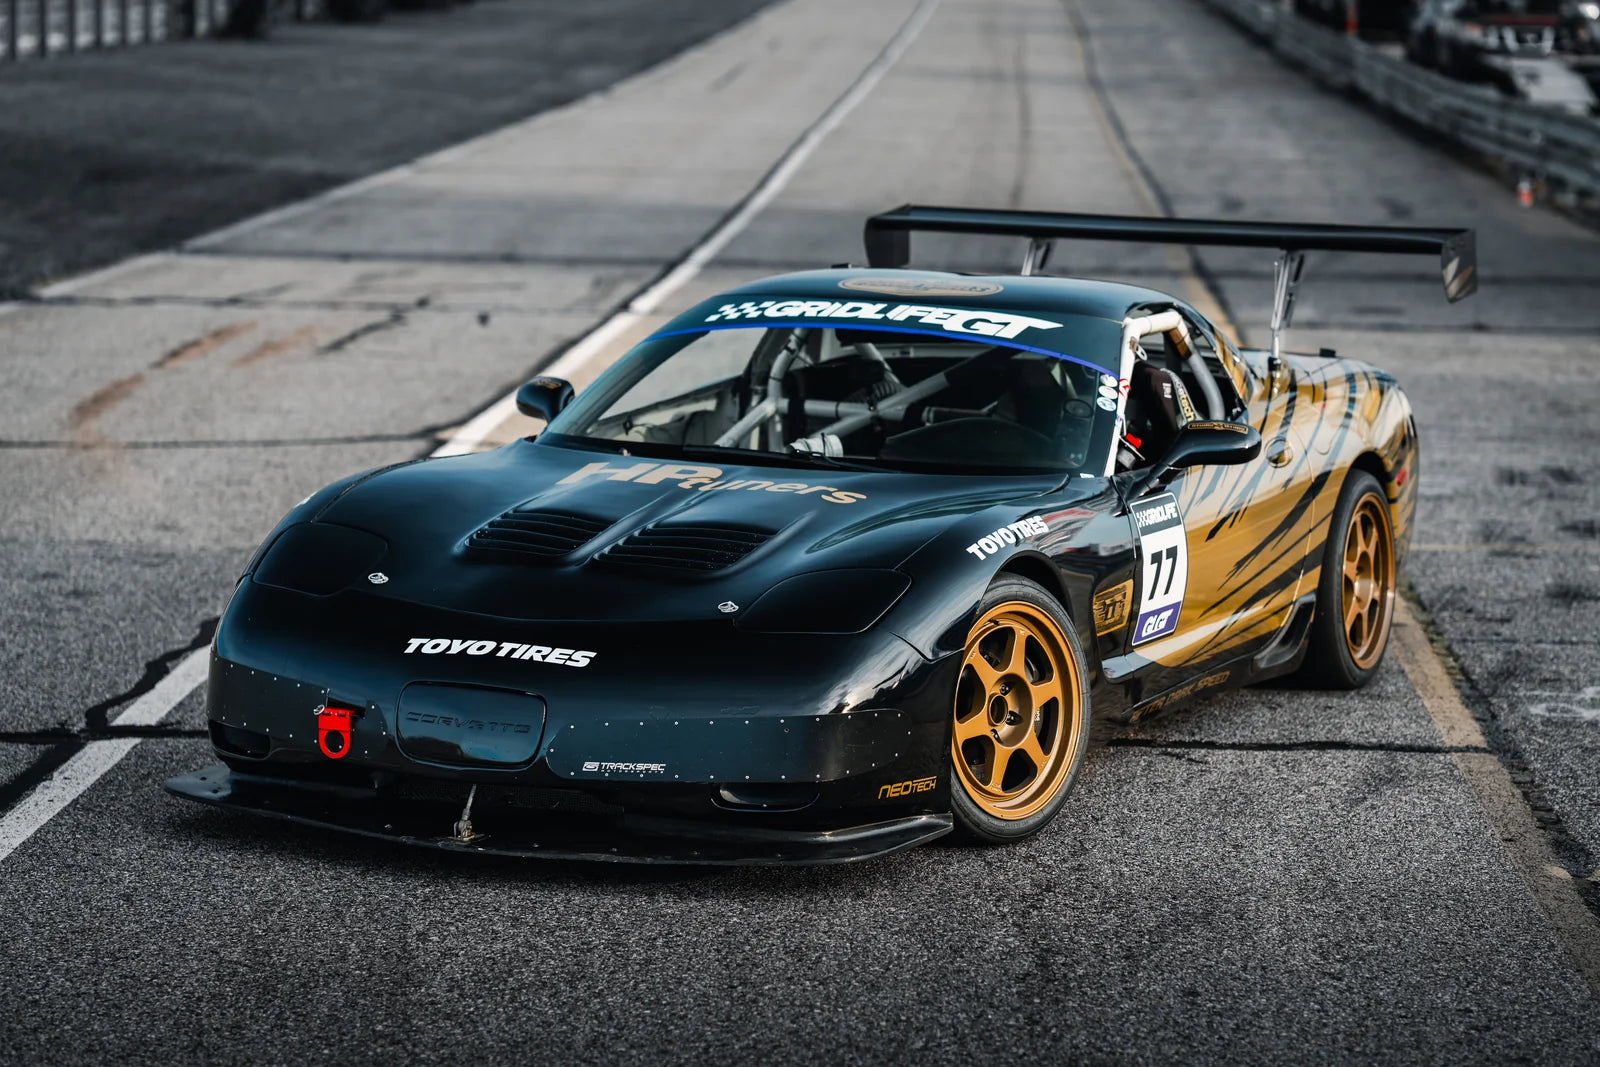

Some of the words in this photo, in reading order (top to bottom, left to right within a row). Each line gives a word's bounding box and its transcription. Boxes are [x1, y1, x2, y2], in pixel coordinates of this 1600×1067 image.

[555, 462, 723, 485] HP
[966, 527, 1016, 560] TOYO
[1007, 515, 1049, 540] TIRES
[1148, 545, 1178, 601] 77
[403, 637, 497, 655] TOYO
[496, 642, 597, 668] TIRES
[600, 762, 666, 771] TRACKSPEC
